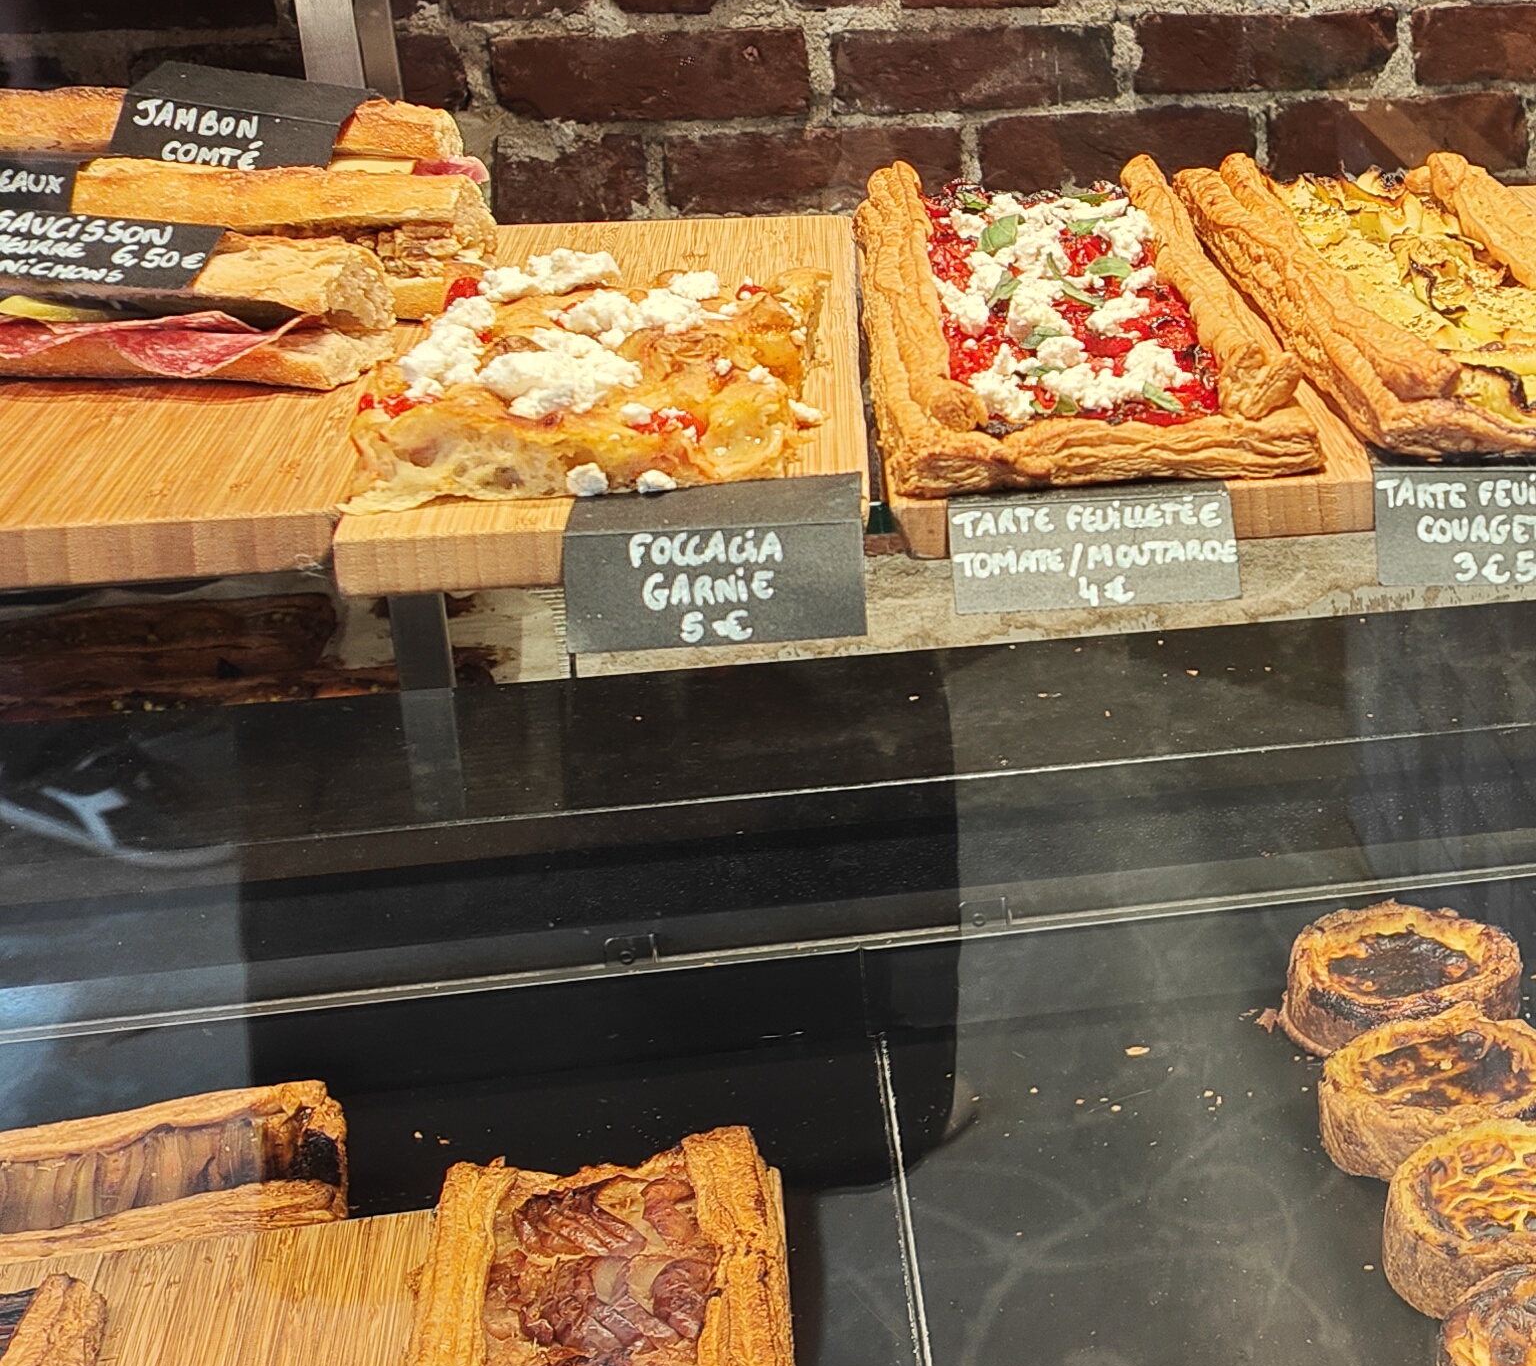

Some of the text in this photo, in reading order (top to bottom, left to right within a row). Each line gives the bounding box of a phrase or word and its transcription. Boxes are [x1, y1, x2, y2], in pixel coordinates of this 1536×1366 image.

[132, 98, 259, 139] JAMBON
[161, 140, 264, 171] COMTÉ
[111, 245, 206, 270] 6,50€
[1376, 476, 1468, 510] TARTE
[951, 505, 1054, 538] TARTE
